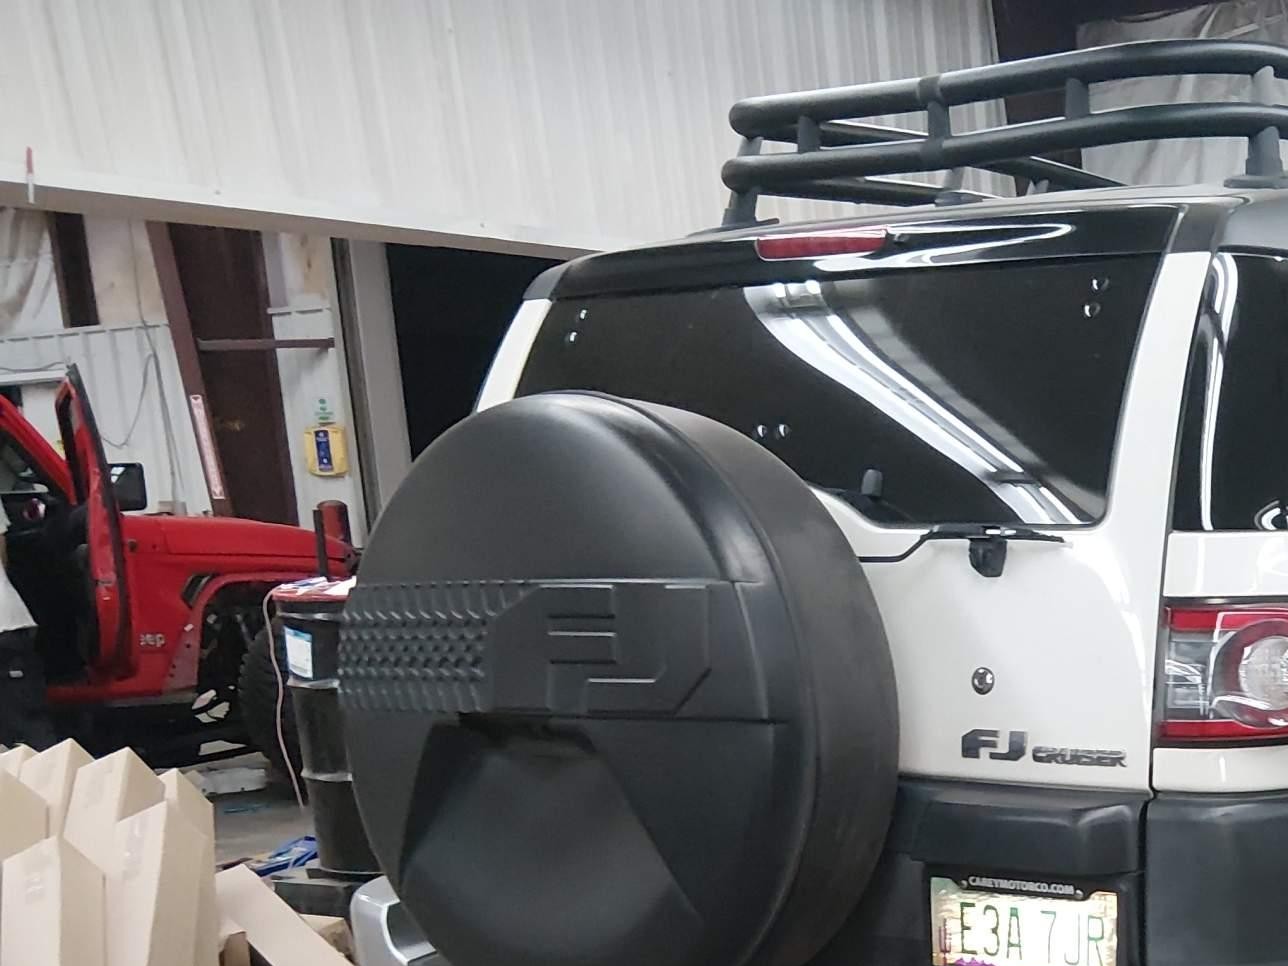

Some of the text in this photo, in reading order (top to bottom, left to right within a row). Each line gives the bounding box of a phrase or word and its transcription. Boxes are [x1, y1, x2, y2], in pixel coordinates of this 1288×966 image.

[961, 729, 1127, 768] FJ CRUISER
[968, 876, 1074, 895] CAREYMOTORCO.COM
[960, 902, 1022, 960] E3A
